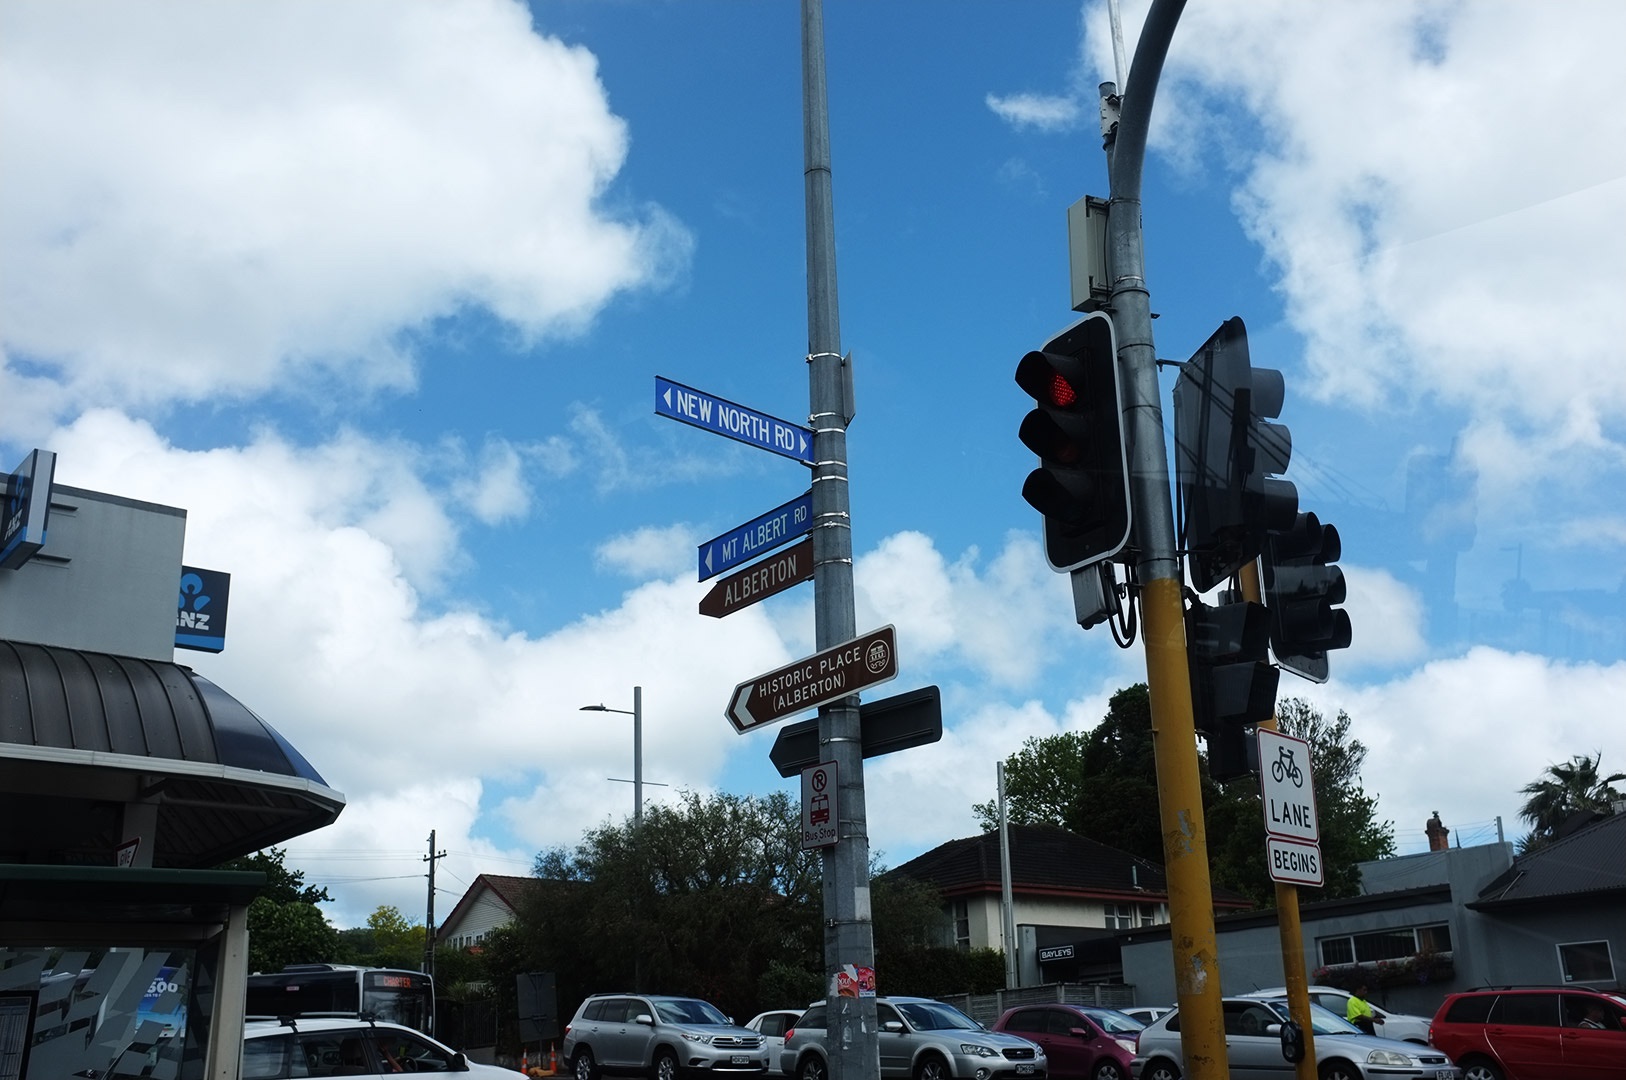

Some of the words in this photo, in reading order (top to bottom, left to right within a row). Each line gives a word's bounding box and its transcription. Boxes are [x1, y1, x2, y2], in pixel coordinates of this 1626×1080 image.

[676, 390, 712, 423] NEW
[718, 404, 770, 444] NORTH
[774, 424, 795, 451] RD
[722, 540, 738, 563] MT
[742, 513, 787, 554] ALBERT
[794, 505, 807, 525] RD
[724, 554, 797, 607] ALBERTON
[759, 665, 812, 698] HISTORIC
[819, 646, 861, 675] PLACE
[772, 671, 846, 713] (ALBERTON)
[1271, 799, 1312, 829] LANE
[805, 830, 818, 842] Bus
[819, 827, 836, 840] Stop
[1274, 850, 1317, 874] BEGINS
[1041, 948, 1072, 959] BAYLEYS
[383, 975, 411, 988] CHARTER
